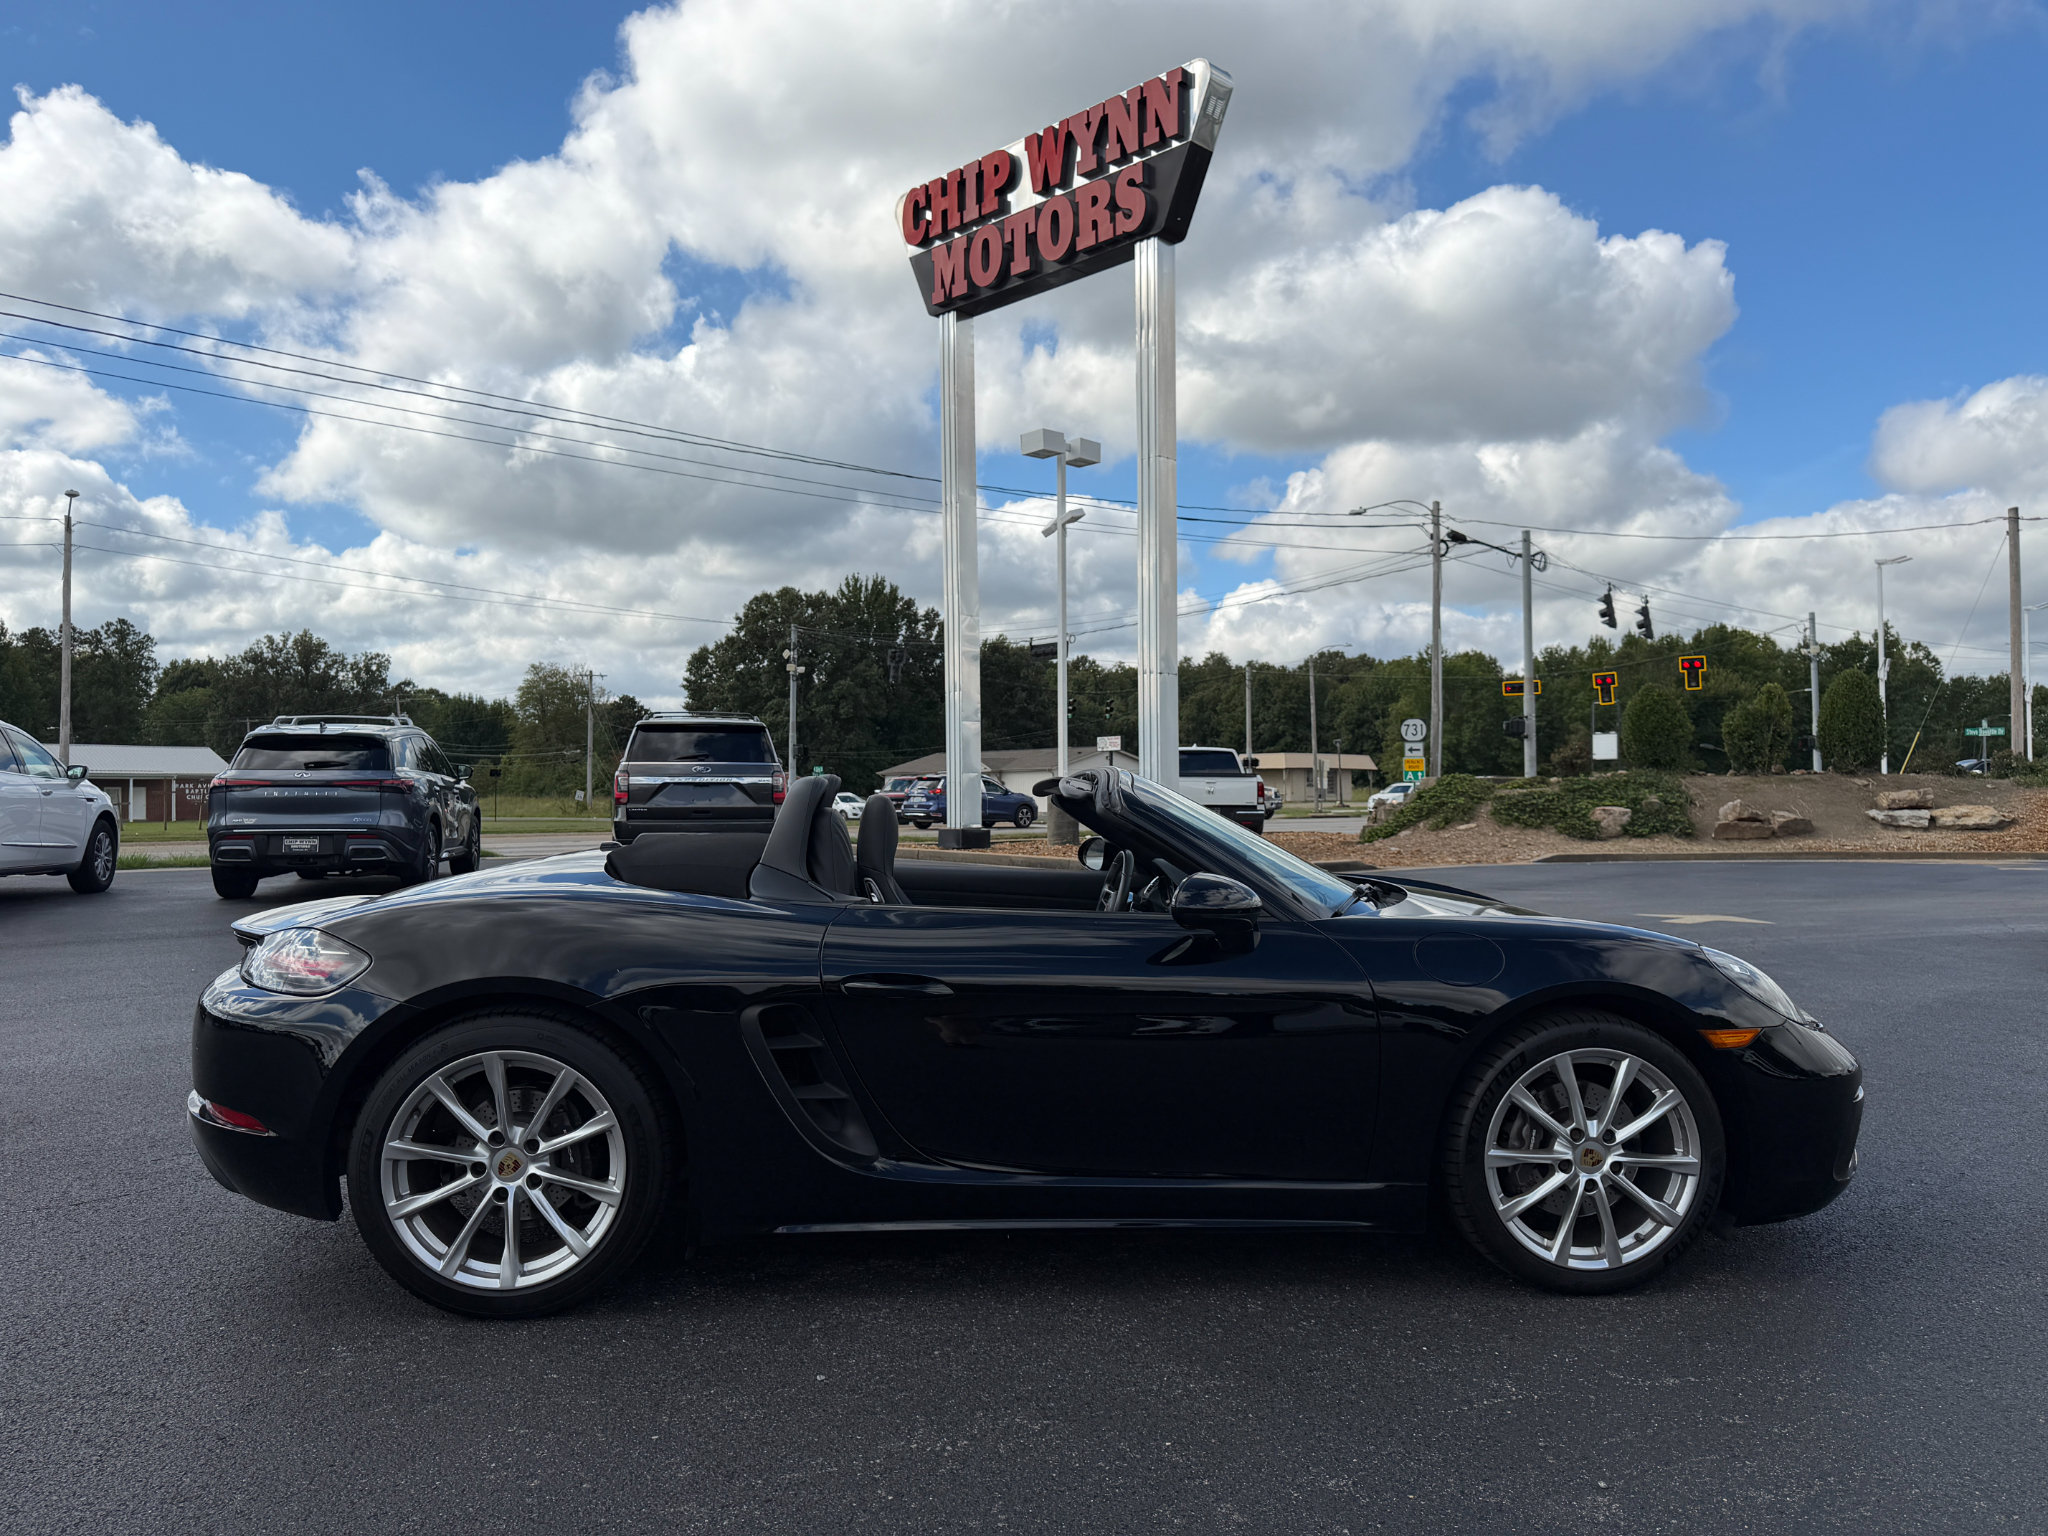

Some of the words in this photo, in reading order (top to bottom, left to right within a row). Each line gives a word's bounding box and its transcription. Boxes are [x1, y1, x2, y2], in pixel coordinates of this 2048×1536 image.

[902, 149, 1011, 245] CHIP
[1025, 66, 1187, 194] WYNN
[931, 162, 1147, 305] MOTORS
[1404, 724, 1423, 736] 731
[1406, 771, 1414, 780] A
